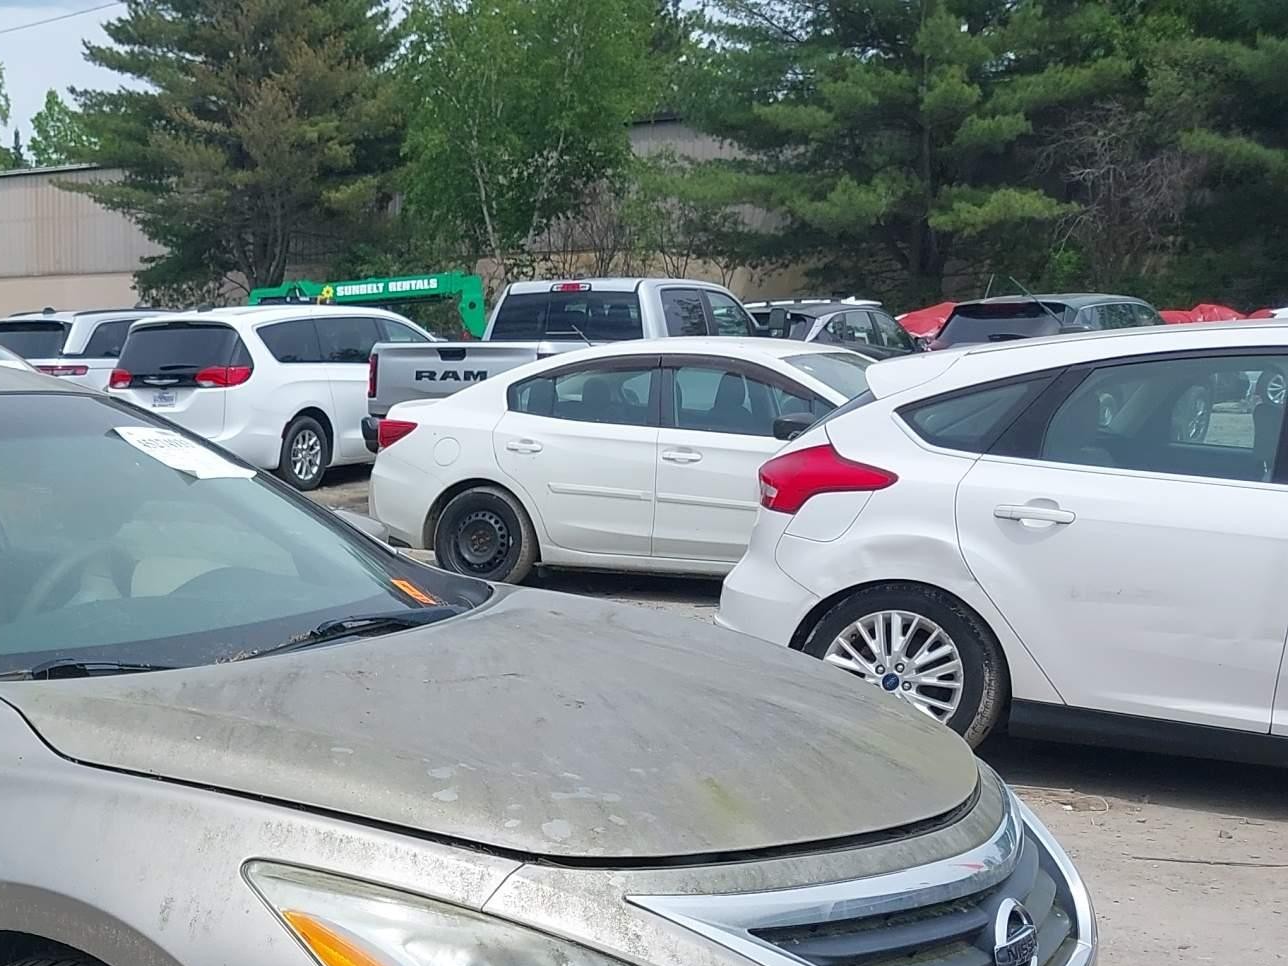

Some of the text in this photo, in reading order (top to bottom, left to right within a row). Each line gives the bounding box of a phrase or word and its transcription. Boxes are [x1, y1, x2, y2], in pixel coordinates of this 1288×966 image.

[336, 278, 438, 296] SUNBELT RENTALS
[415, 370, 488, 381] RAM
